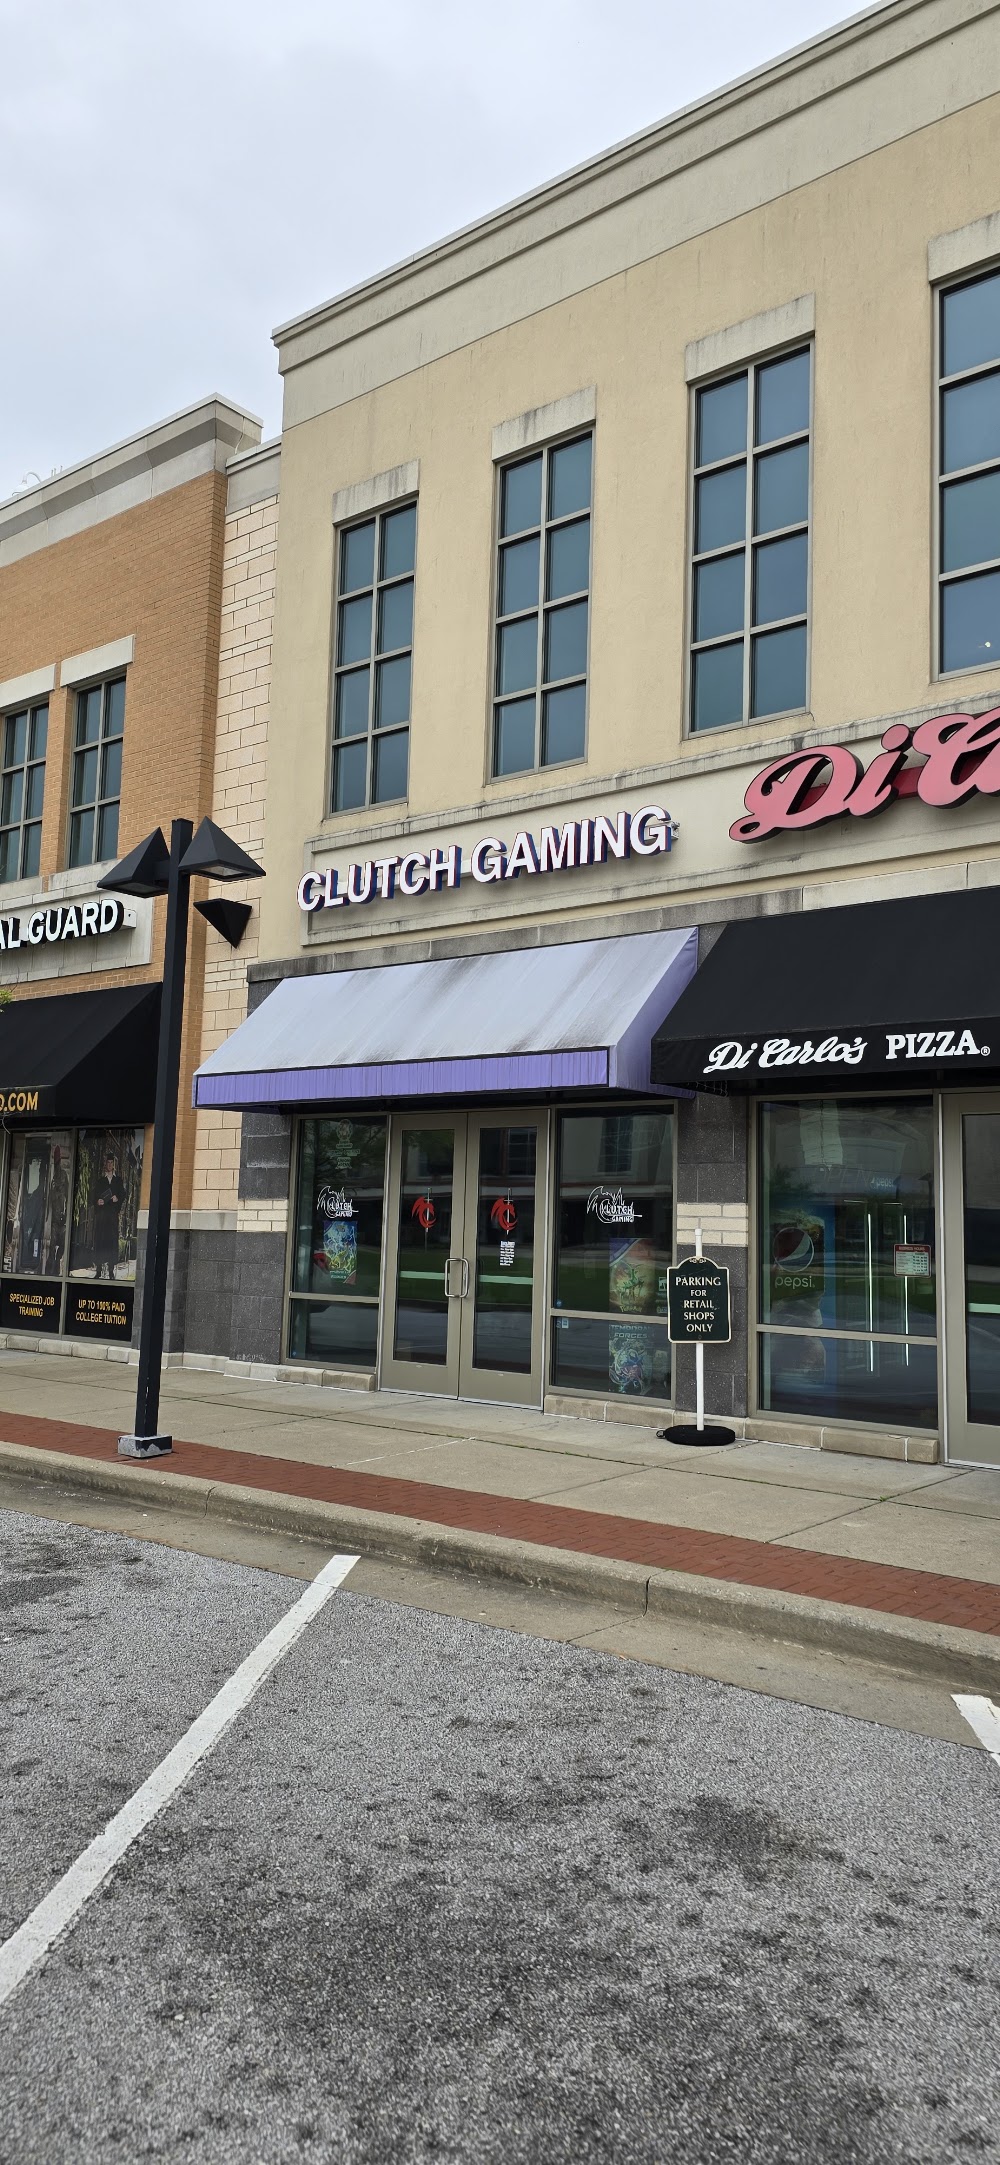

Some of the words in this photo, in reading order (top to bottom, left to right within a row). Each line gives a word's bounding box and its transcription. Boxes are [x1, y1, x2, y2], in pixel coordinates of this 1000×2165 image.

[729, 723, 912, 843] Di
[297, 845, 460, 912] CLUTCH
[471, 804, 671, 884] GAMING
[28, 899, 121, 945] GUARD
[702, 1041, 758, 1073] Di
[758, 1036, 869, 1068] Carlo's
[675, 1276, 722, 1286] PARKING
[774, 1275, 813, 1289] pepsi
[9, 1293, 42, 1305] SPECIALIZED
[43, 1296, 55, 1306] JOB
[690, 1289, 707, 1297] FOR
[78, 1299, 87, 1309] UP
[87, 1300, 96, 1310] TO
[111, 1302, 126, 1312] PAID
[683, 1299, 715, 1309] RETAIL
[19, 1306, 43, 1317] TRAINING
[75, 1311, 103, 1323] COLLEGE
[103, 1314, 127, 1325] TUITION
[683, 1311, 715, 1320] SHOPS
[686, 1323, 713, 1332] ONLY
